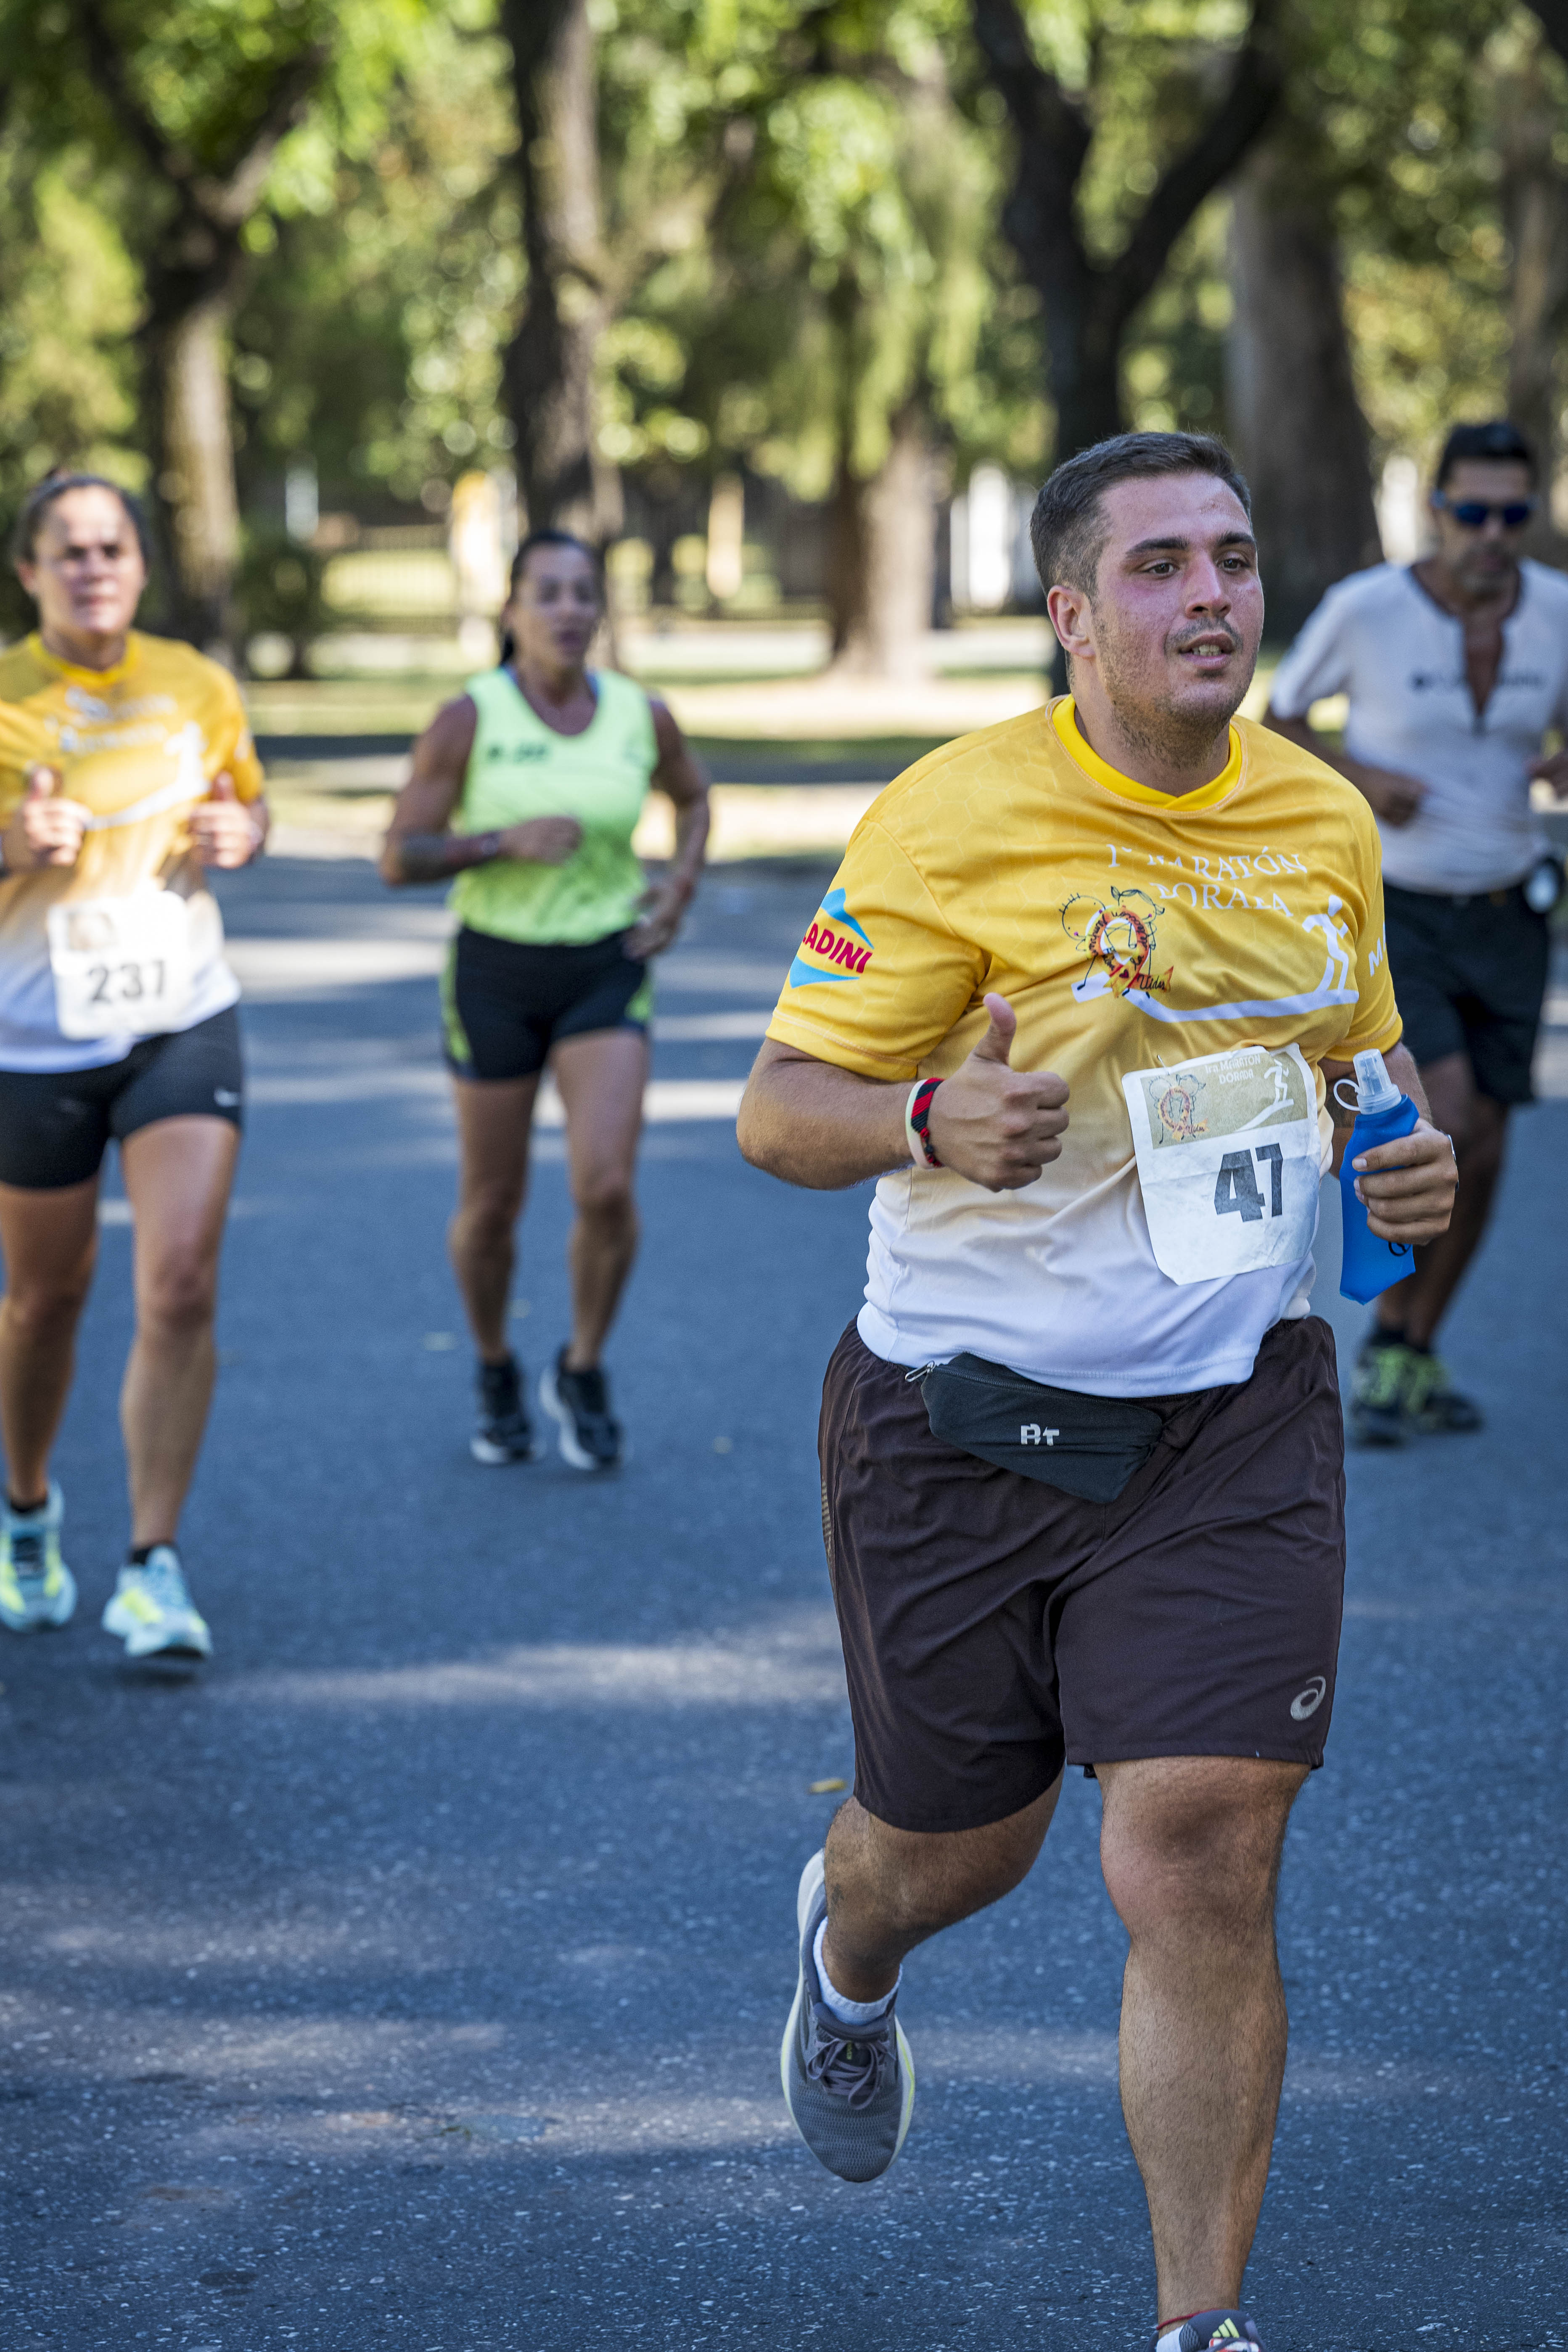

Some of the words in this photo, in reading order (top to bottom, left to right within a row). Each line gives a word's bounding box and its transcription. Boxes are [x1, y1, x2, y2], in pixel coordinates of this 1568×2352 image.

[802, 922, 873, 974] ADINI
[87, 959, 166, 1004] 237
[1219, 1069, 1253, 1085] DORADA
[1214, 1143, 1283, 1222] 47
